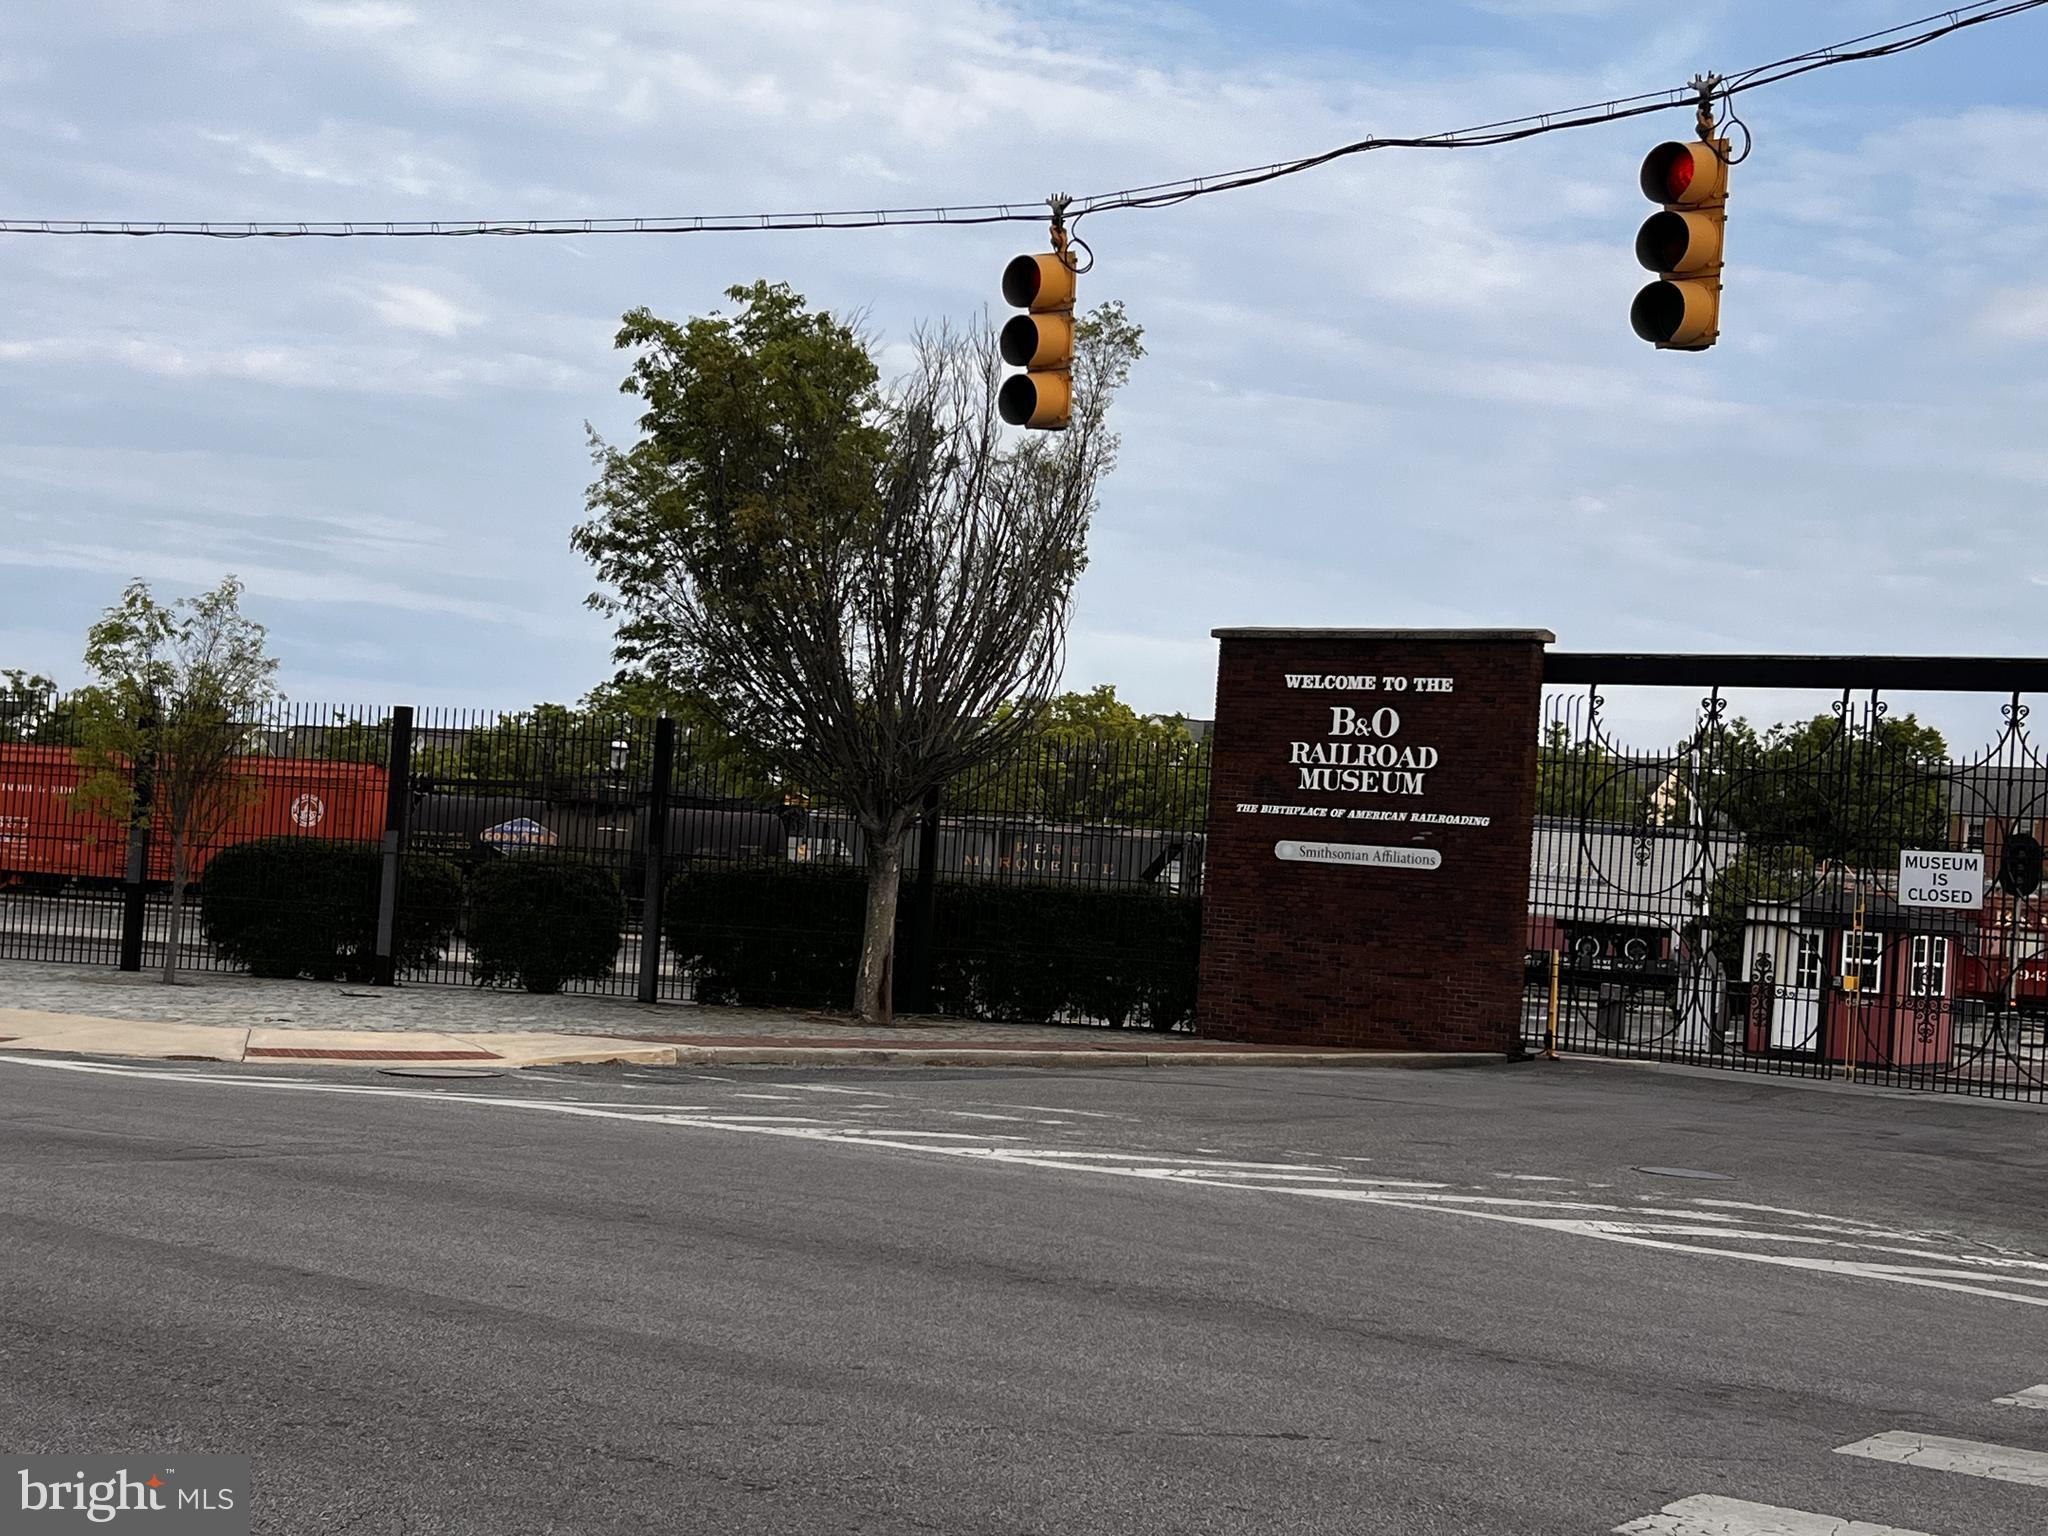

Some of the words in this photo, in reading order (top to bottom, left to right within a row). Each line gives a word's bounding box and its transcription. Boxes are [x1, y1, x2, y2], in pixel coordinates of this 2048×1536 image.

[1285, 674, 1376, 690] WELCOME
[1383, 676, 1407, 691] TO
[1413, 677, 1454, 692] THE
[1328, 706, 1400, 738] B&O
[1288, 742, 1439, 769] RAILROAD
[1298, 767, 1426, 795] MUSEUM
[1236, 803, 1258, 813] THE
[1261, 804, 1328, 817] BIRTHPLACE
[1330, 809, 1345, 818] OF
[1347, 810, 1407, 821] AMERICAN
[1411, 813, 1490, 826] RAILROADING
[1015, 841, 1081, 855] PERE
[1299, 845, 1369, 862] Smithsonian
[1372, 848, 1436, 866] Affiliations
[964, 855, 1115, 875] MARQUETTE
[1905, 856, 1978, 872] MUSEUM
[1932, 873, 1948, 886] IS
[1908, 887, 1973, 904] CLOSED
